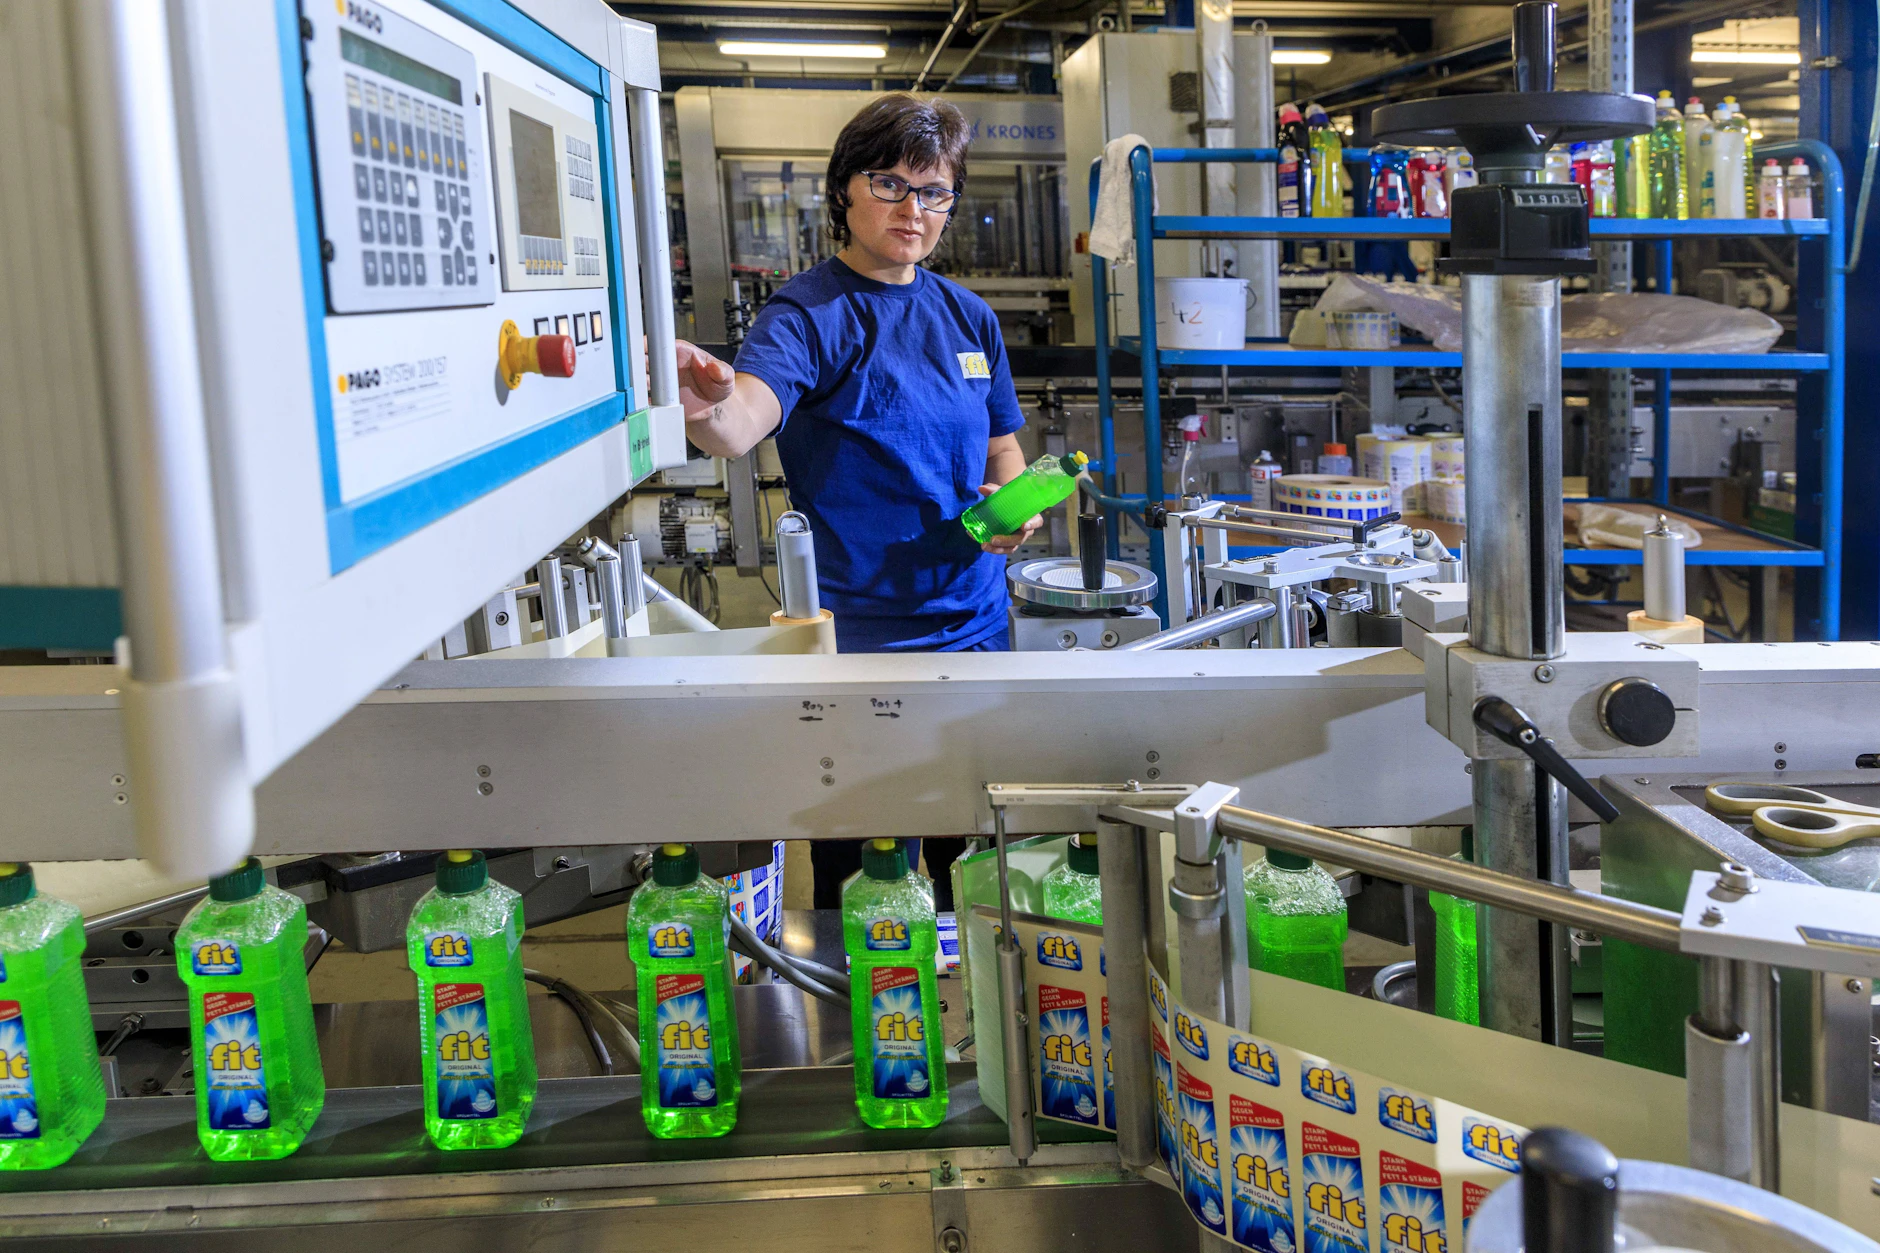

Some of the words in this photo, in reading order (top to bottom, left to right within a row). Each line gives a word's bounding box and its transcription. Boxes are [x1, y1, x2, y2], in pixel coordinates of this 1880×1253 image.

[986, 124, 1056, 140] KRONES
[348, 368, 381, 392] PAGO
[653, 926, 691, 948] fit
[871, 919, 906, 941] fit
[198, 943, 236, 965] fit
[430, 935, 468, 957] fit
[1042, 936, 1078, 961] fit
[658, 976, 677, 984] STARK
[873, 968, 893, 977] STARK
[874, 974, 894, 983] GEGEN
[436, 985, 456, 994] STARK
[659, 981, 678, 991] GEGEN
[659, 991, 674, 999] FETT
[679, 981, 702, 992] STÄRKE
[874, 981, 888, 990] FETT
[894, 974, 917, 984] STÄRKE
[1041, 987, 1059, 995] STARK
[206, 994, 226, 1003] STARK
[437, 991, 457, 1000] GEGEN
[437, 1000, 451, 1008] FETT
[458, 990, 482, 1002] STÄRKE
[1041, 1001, 1055, 1009] FETT
[1061, 998, 1084, 1006] STÄRKE
[1042, 994, 1060, 1002] GEGEN
[207, 1000, 227, 1010] GEGEN
[207, 1009, 222, 1017] FETT
[228, 999, 252, 1011] STÄRKE
[660, 1020, 710, 1050] fit
[875, 1012, 923, 1041] fit
[1175, 1012, 1204, 1048] fit
[439, 1030, 490, 1061] fit
[1042, 1033, 1092, 1067] fit
[0, 1049, 29, 1079] it
[209, 1040, 261, 1070] fit
[1234, 1042, 1275, 1073] fit
[1051, 1064, 1084, 1075] ORIGINAL
[1240, 1066, 1268, 1081] ORIGINAL
[1307, 1067, 1350, 1100] fit
[1156, 1076, 1176, 1127] fit
[1231, 1099, 1253, 1108] STARK
[1314, 1093, 1344, 1108] ORIGINAL
[1232, 1107, 1253, 1115] GEGEN
[1232, 1115, 1248, 1123] FETT
[1255, 1115, 1281, 1125] STÄRKE
[1385, 1094, 1432, 1130] fit
[1304, 1127, 1326, 1135] STARK
[1392, 1121, 1424, 1136] ORIGINAL
[1181, 1119, 1218, 1169] fit
[1304, 1135, 1328, 1143] GEGEN
[1469, 1123, 1520, 1161] fit
[1330, 1144, 1357, 1154] STÄRKE
[1382, 1156, 1406, 1164] STARK
[1383, 1164, 1407, 1172] GEGEN
[1233, 1153, 1289, 1198] fit
[1402, 1174, 1408, 1182] &
[1409, 1175, 1438, 1184] STÄRKE
[1243, 1187, 1281, 1206] ORIGINAL
[1306, 1182, 1365, 1229] fit
[1316, 1216, 1357, 1237] ORIGINAL
[1383, 1213, 1447, 1253] fit
